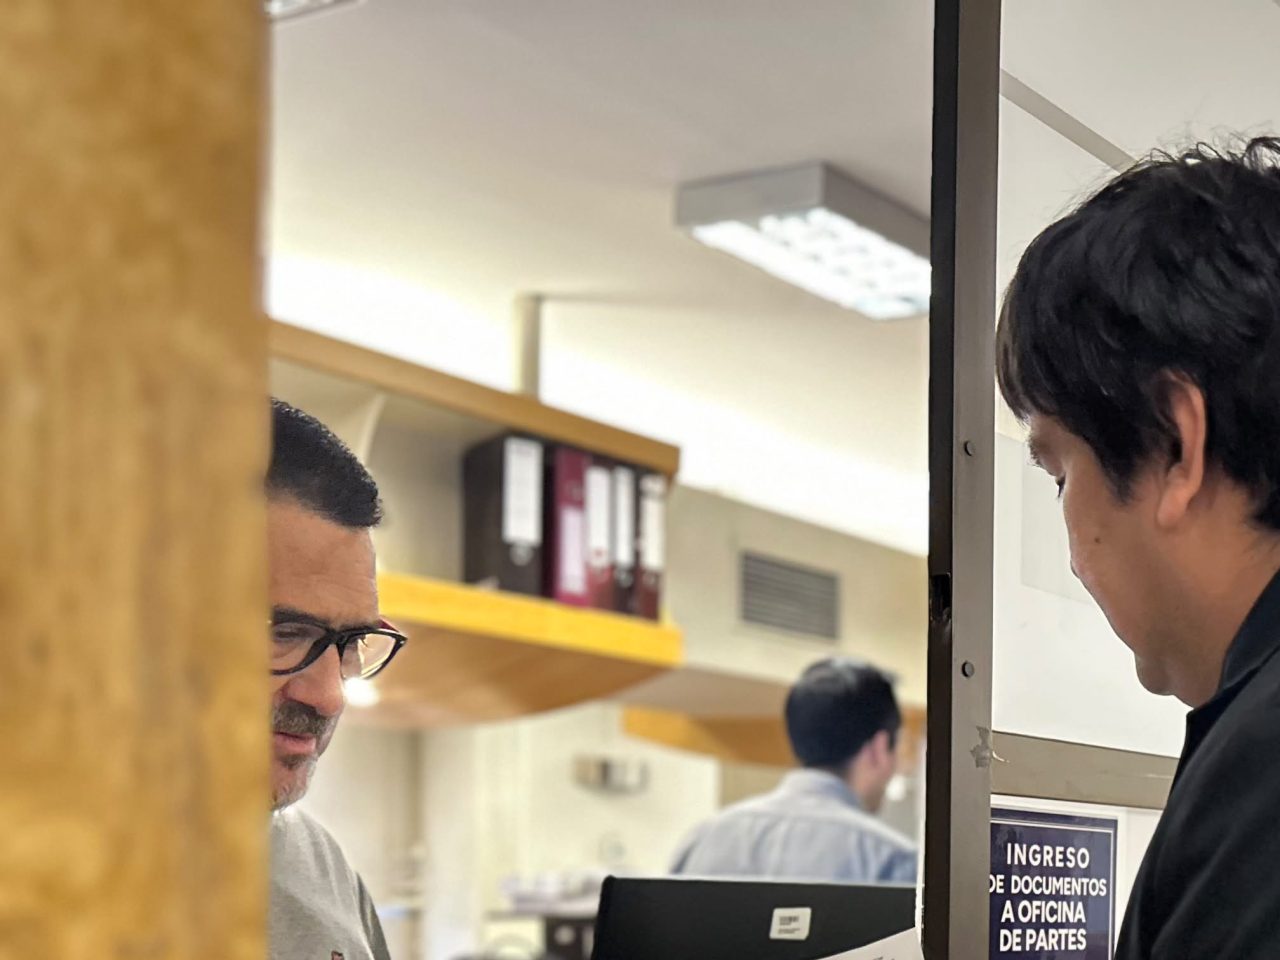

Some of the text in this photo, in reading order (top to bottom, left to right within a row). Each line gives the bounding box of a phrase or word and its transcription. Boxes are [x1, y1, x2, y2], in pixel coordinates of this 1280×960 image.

[1007, 843, 1089, 868] INGRESO
[1011, 875, 1107, 896] DOCUMENTOS
[1001, 900, 1086, 923] A OFICINA
[1000, 928, 1086, 951] DE PARTES
